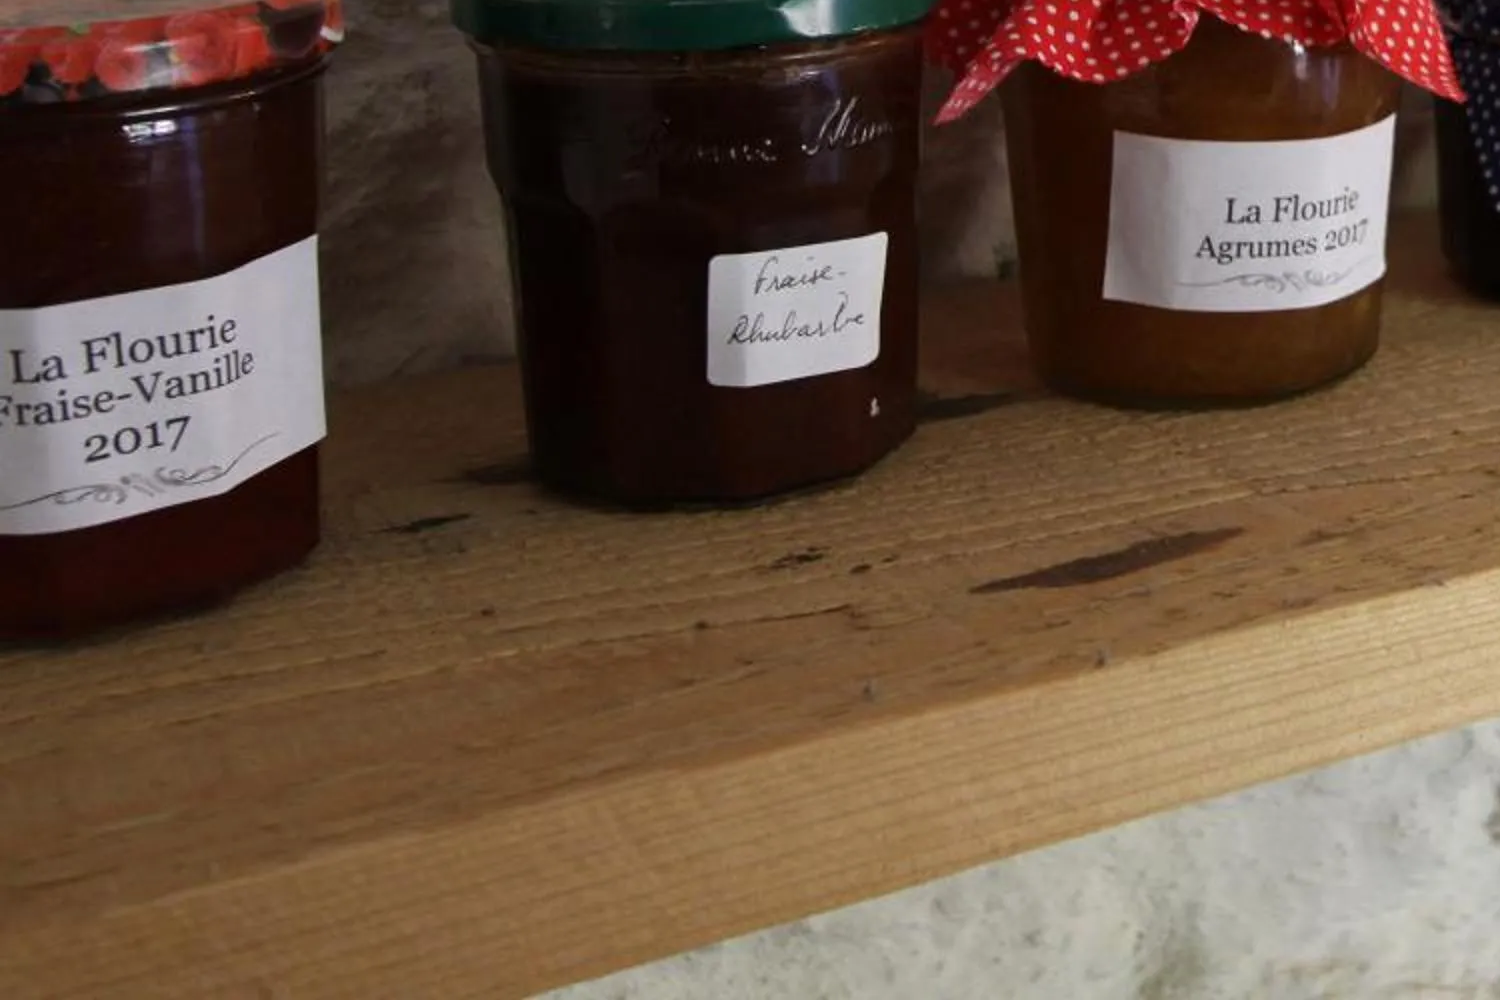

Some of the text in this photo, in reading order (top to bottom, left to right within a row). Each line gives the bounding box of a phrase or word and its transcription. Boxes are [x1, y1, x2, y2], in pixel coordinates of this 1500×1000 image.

[1225, 187, 1360, 225] La Flourie
[1195, 219, 1369, 266] Agrumes 2017
[10, 314, 237, 384] La Flourie
[84, 415, 192, 464] 2017
